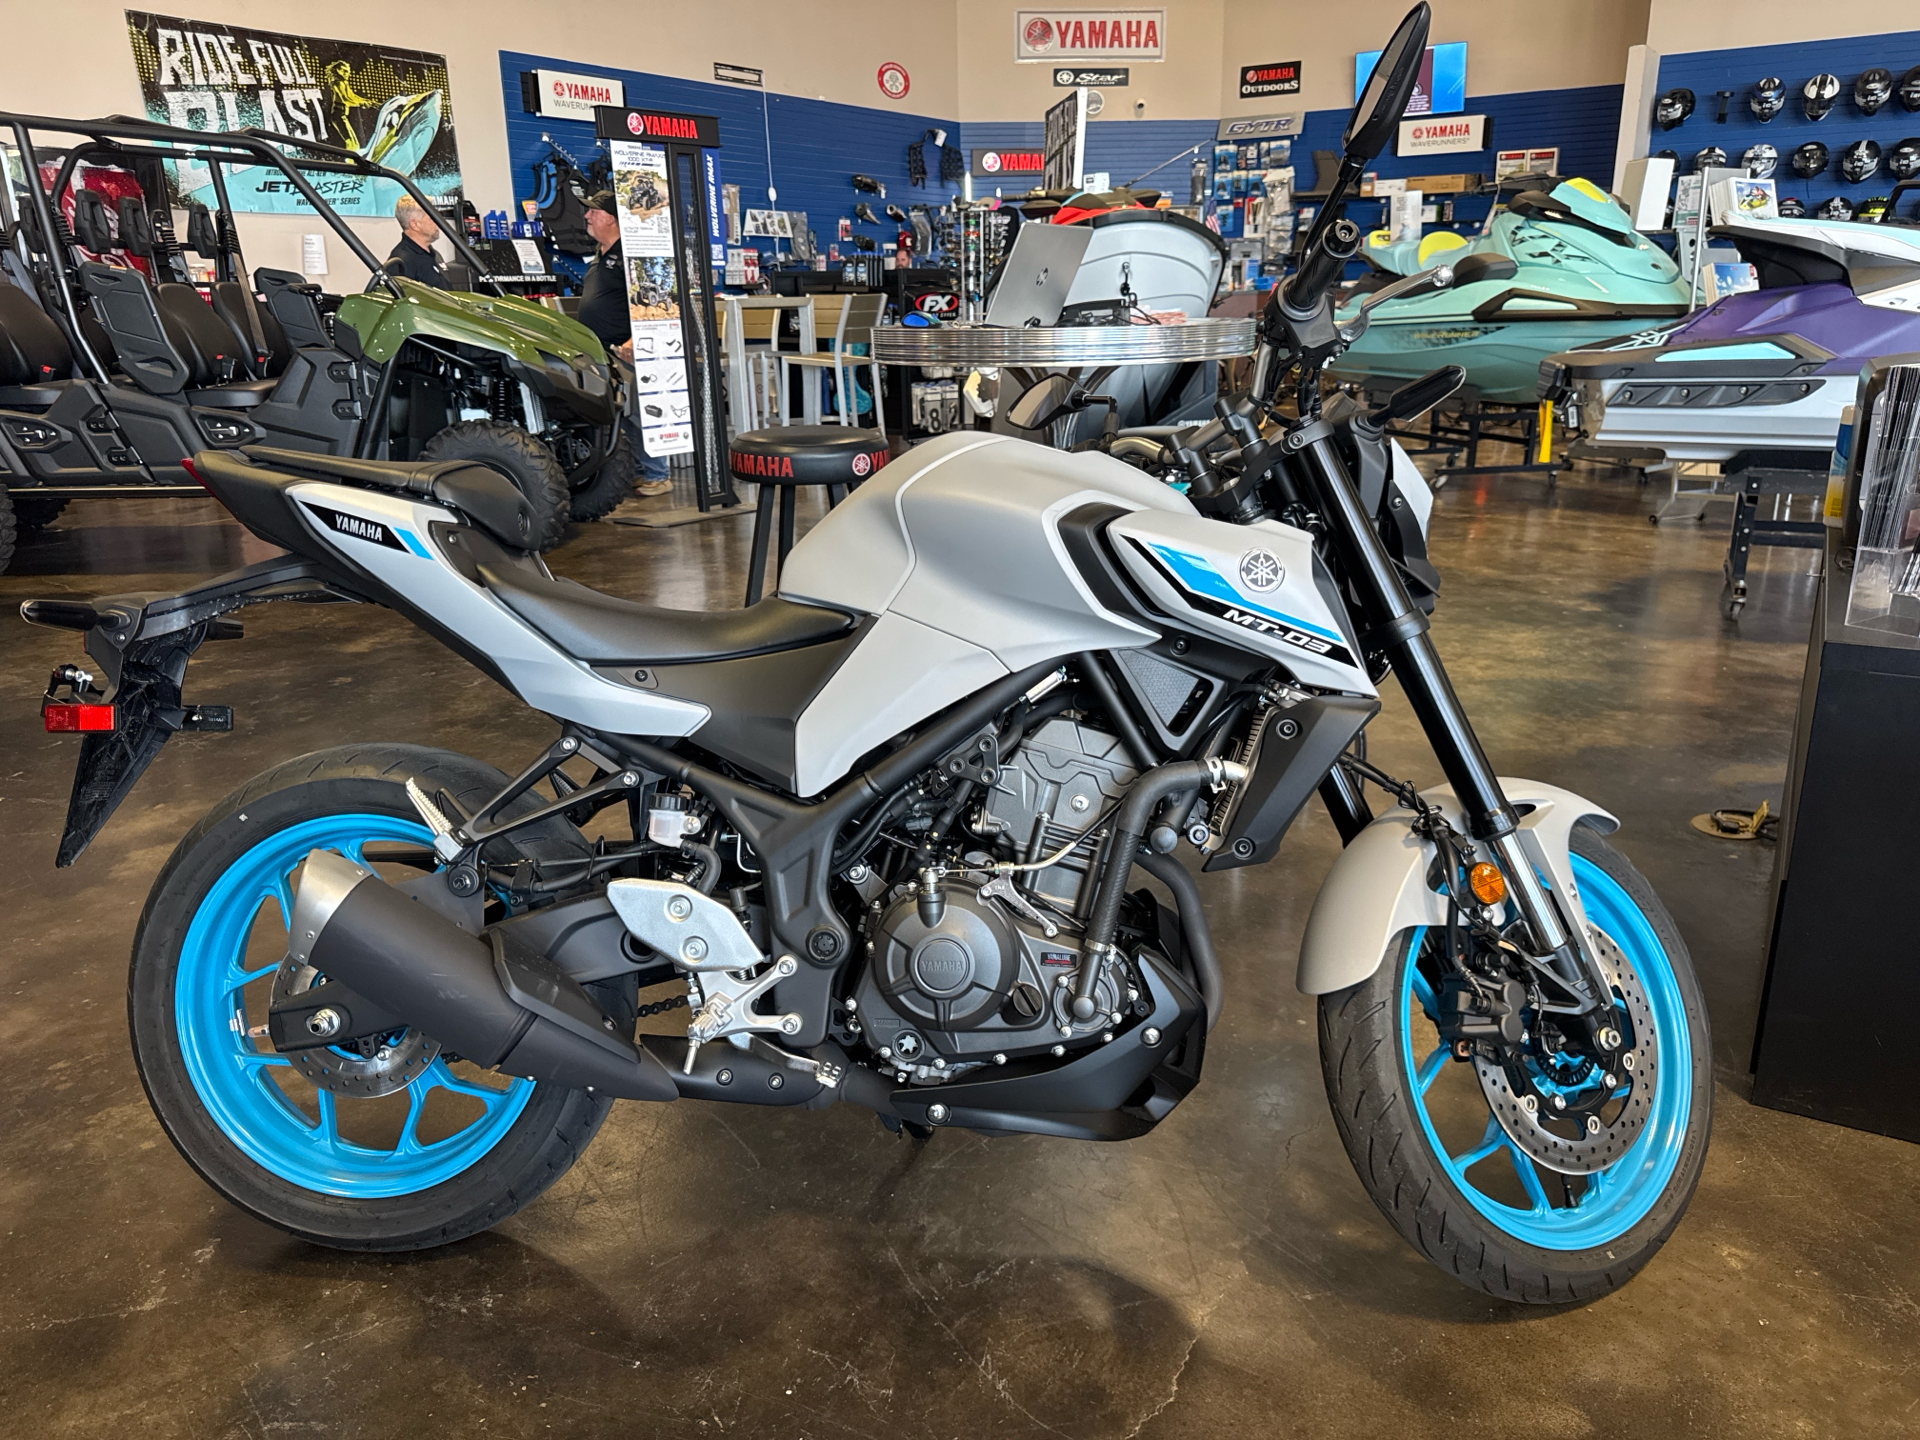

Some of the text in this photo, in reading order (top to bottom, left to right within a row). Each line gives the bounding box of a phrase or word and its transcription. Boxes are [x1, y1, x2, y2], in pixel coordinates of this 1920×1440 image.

[1055, 20, 1159, 48] YAMAHA
[157, 28, 316, 86] RIDE FULL
[1075, 72, 1126, 83] Star
[1257, 67, 1295, 80] YAMAHA
[566, 82, 612, 103] YAMAHA
[643, 114, 698, 139] YAMAHA
[1225, 117, 1291, 135] GYTR
[1425, 123, 1470, 137] YAMAHA
[1410, 138, 1470, 148] WAVERUNNERS
[1000, 153, 1044, 171] YAMA
[706, 154, 719, 237] WOLVERINE RMAX
[923, 295, 952, 312] FX
[930, 408, 941, 432] 8
[731, 450, 794, 477] YAMAHA
[335, 513, 383, 542] YAMAHA
[1222, 608, 1333, 654] MT-03
[921, 960, 965, 972] YAMAHA
